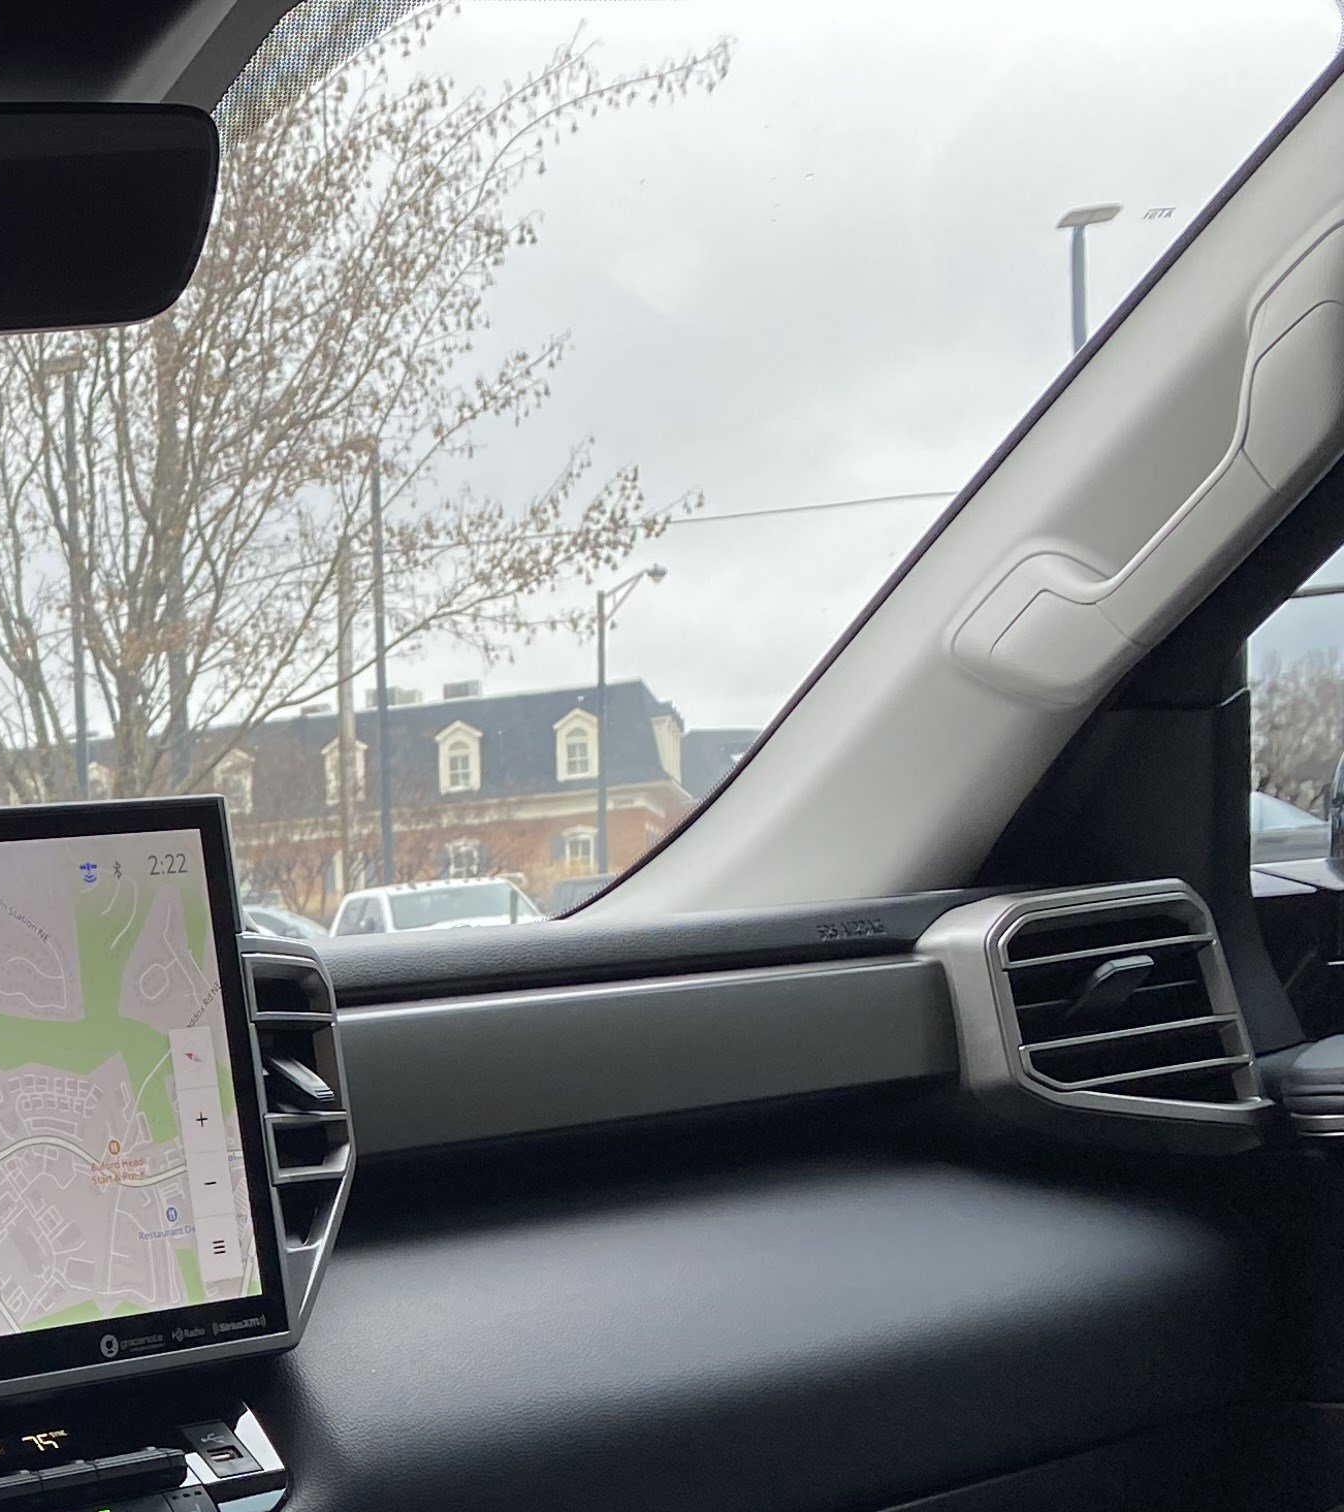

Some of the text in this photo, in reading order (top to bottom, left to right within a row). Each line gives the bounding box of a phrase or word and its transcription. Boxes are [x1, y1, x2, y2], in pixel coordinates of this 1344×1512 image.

[147, 853, 188, 876] 2:22
[8, 906, 38, 932] Station
[36, 925, 49, 943] NE
[202, 992, 214, 1007] Rd
[90, 1157, 145, 1173] Buford Head
[91, 1174, 114, 1186] Start
[138, 1227, 184, 1241] Restaurant
[22, 1432, 59, 1452] 75
